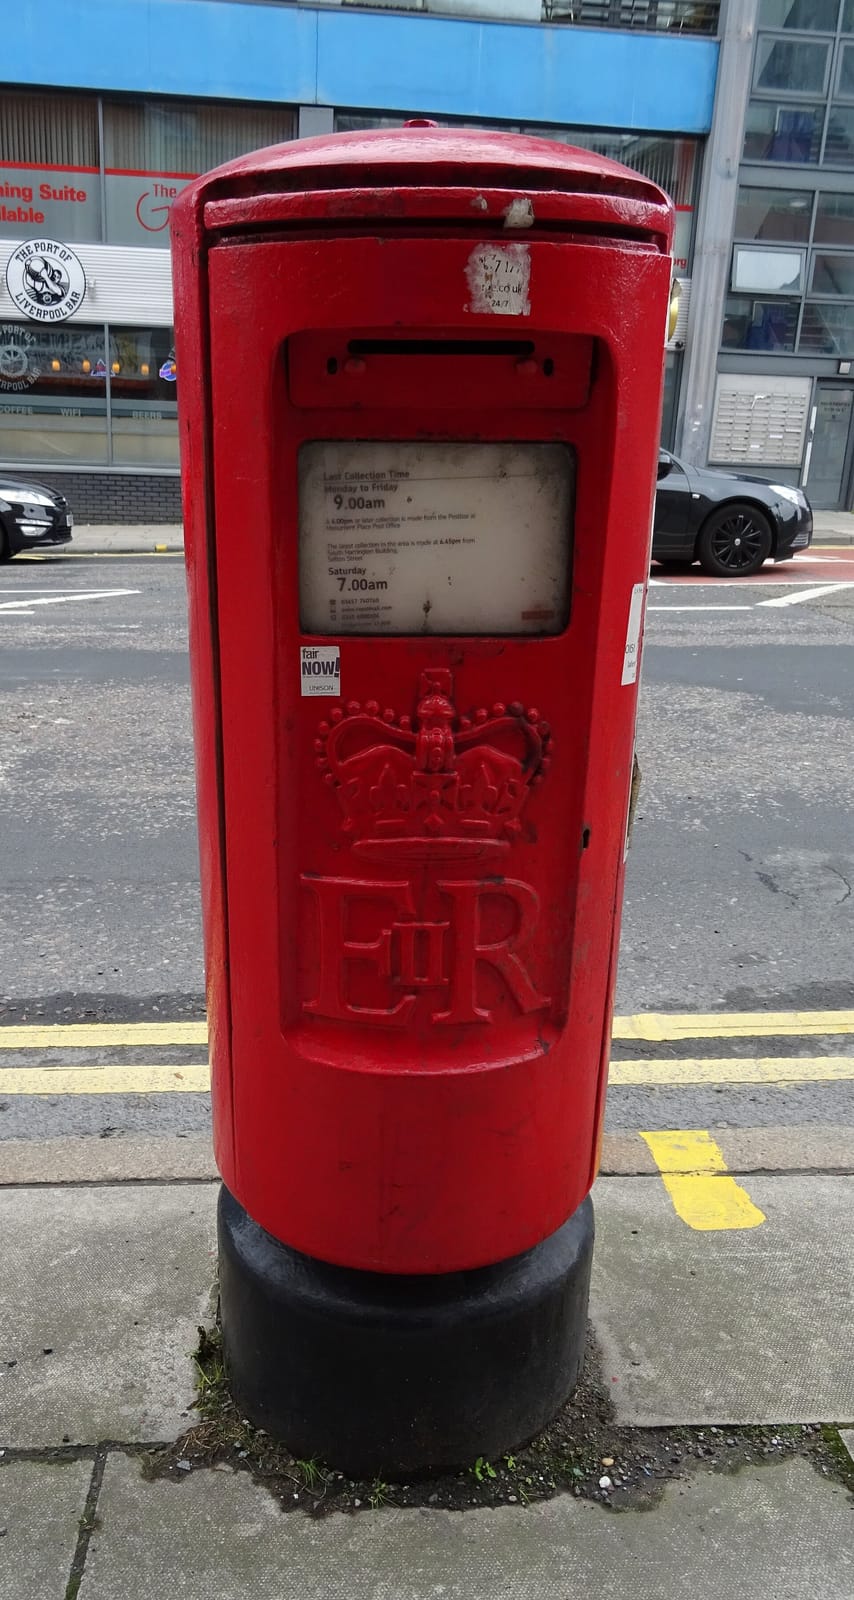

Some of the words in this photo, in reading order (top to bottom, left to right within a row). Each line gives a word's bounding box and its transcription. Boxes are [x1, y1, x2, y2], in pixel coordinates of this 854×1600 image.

[39, 183, 87, 202] Suite
[152, 183, 177, 198] The
[0, 205, 45, 224] lable
[15, 244, 34, 262] THE
[33, 242, 60, 255] PORT
[59, 250, 72, 262] OF
[15, 293, 67, 319] LIVERPOOL
[65, 291, 80, 311] BAR
[2, 324, 25, 336] PORT
[0, 378, 29, 391] RPOOL
[61, 408, 81, 417] WIFI
[323, 472, 341, 481] Last
[344, 472, 386, 480] Collection
[388, 471, 410, 479] Time
[324, 485, 358, 493] Monday
[371, 483, 398, 492] Friday
[333, 494, 385, 510] 9.00am
[328, 566, 367, 576] Saturday
[336, 577, 388, 591] 7.00am
[302, 648, 320, 659] fair
[302, 657, 340, 678] NOW!
